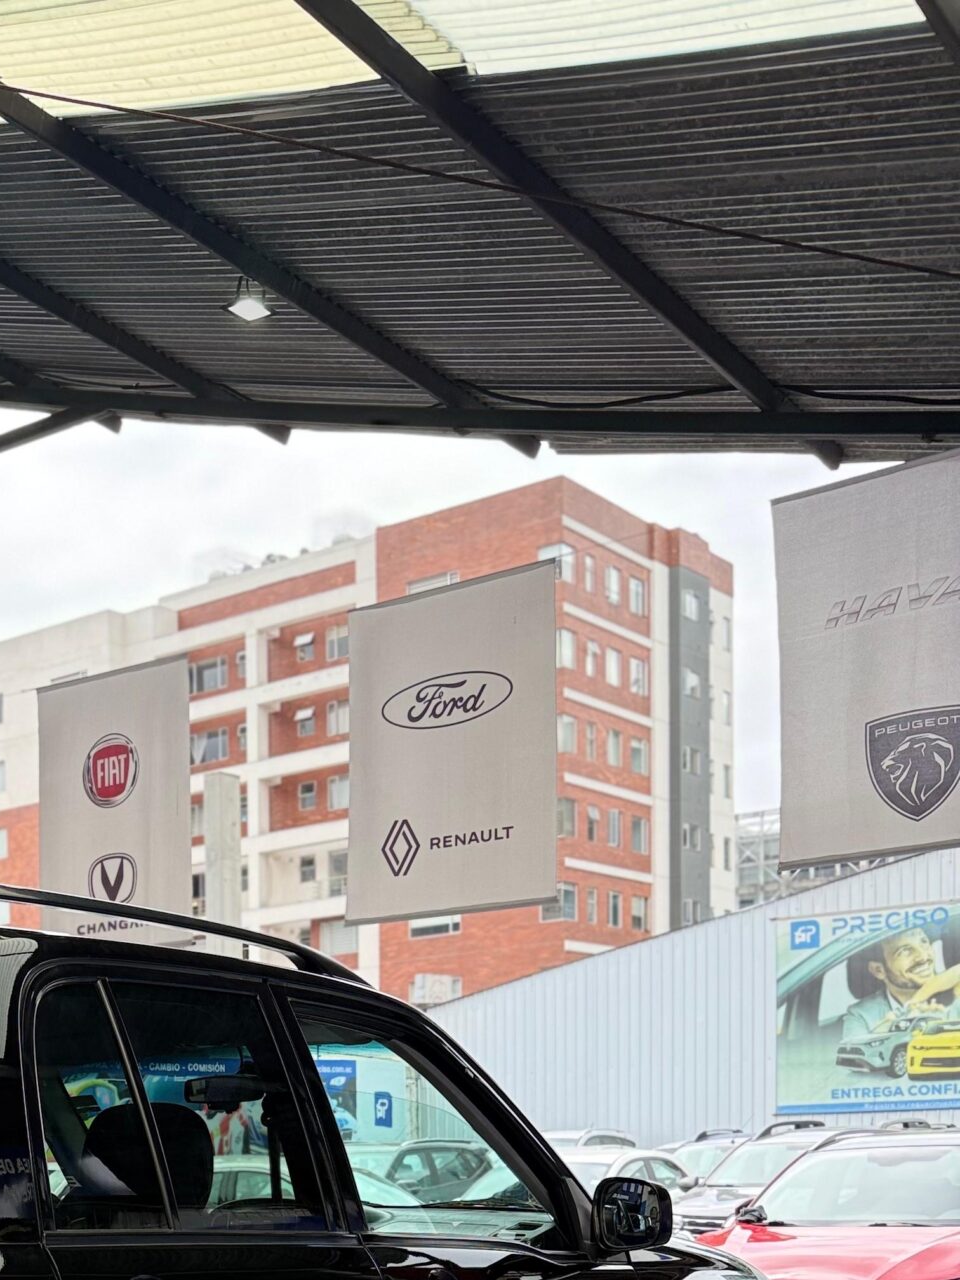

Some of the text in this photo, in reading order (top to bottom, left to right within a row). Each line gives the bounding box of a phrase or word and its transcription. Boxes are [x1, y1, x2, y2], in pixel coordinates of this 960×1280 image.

[407, 679, 487, 723] Ford
[874, 714, 960, 738] PEUGEOT
[96, 753, 128, 789] FIAT
[429, 825, 514, 850] RENAULT
[77, 919, 148, 936] CHANGA
[831, 906, 949, 936] PRECISO
[149, 1062, 181, 1072] CAMBIO
[188, 1062, 226, 1073] COMISIÓN
[831, 1083, 960, 1100] ENTREGA CONFI
